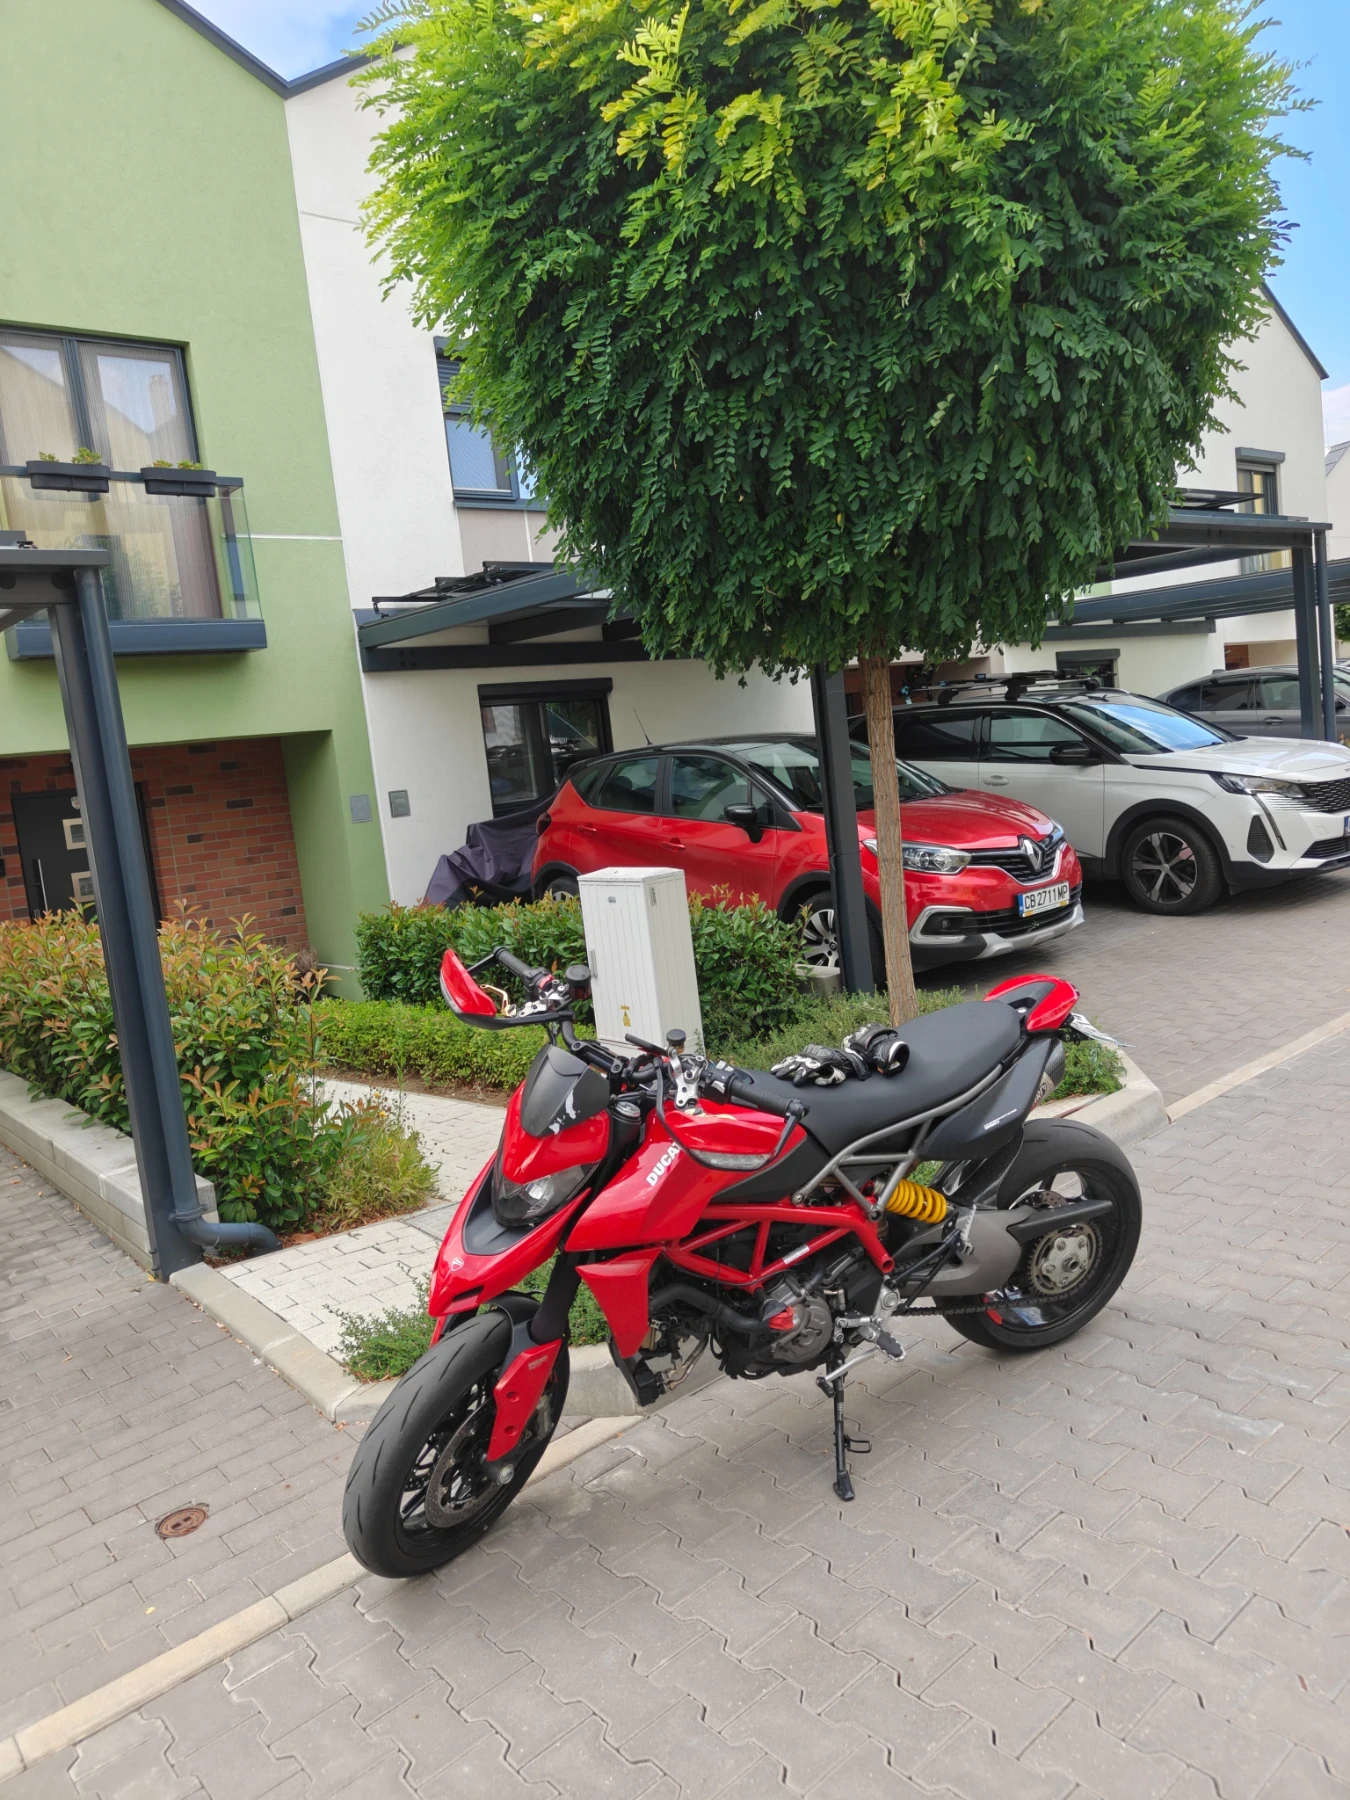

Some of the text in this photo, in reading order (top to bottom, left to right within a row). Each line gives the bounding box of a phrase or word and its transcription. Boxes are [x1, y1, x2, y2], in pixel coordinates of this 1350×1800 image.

[1024, 894, 1036, 909] CB
[1037, 888, 1056, 906] 2711
[646, 1142, 681, 1186] DUCAT
